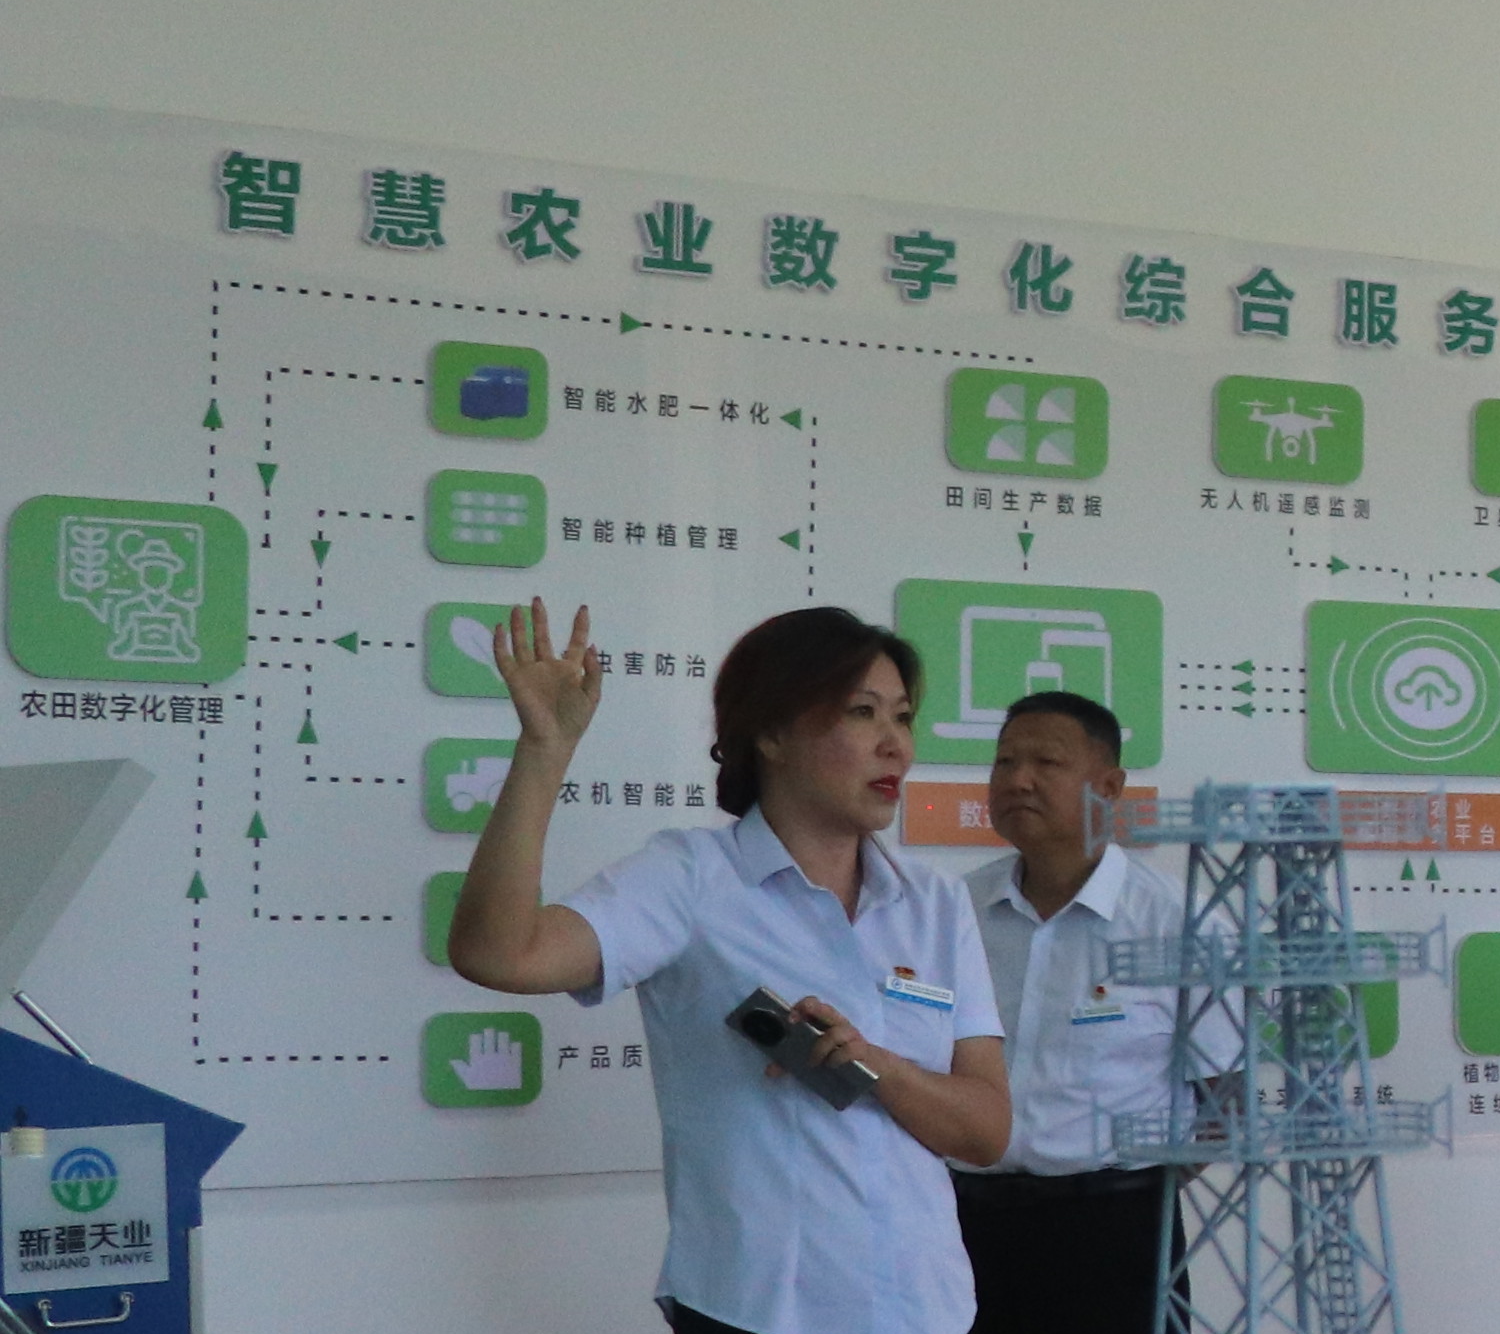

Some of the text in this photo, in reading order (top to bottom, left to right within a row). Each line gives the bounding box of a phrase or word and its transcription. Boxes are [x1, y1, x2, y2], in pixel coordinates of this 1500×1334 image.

[564, 385, 769, 425] 智能水肥一体化
[946, 486, 1102, 517] 田间生产数据
[1201, 488, 1370, 520] 无人机遥感监测
[562, 517, 738, 551] 智能种植管理
[21, 691, 224, 724] 农田数字化管理
[558, 1045, 643, 1069] 产品质
[18, 1219, 153, 1258] 新疆天业
[20, 1251, 153, 1272] XINJIANG TIANYE
